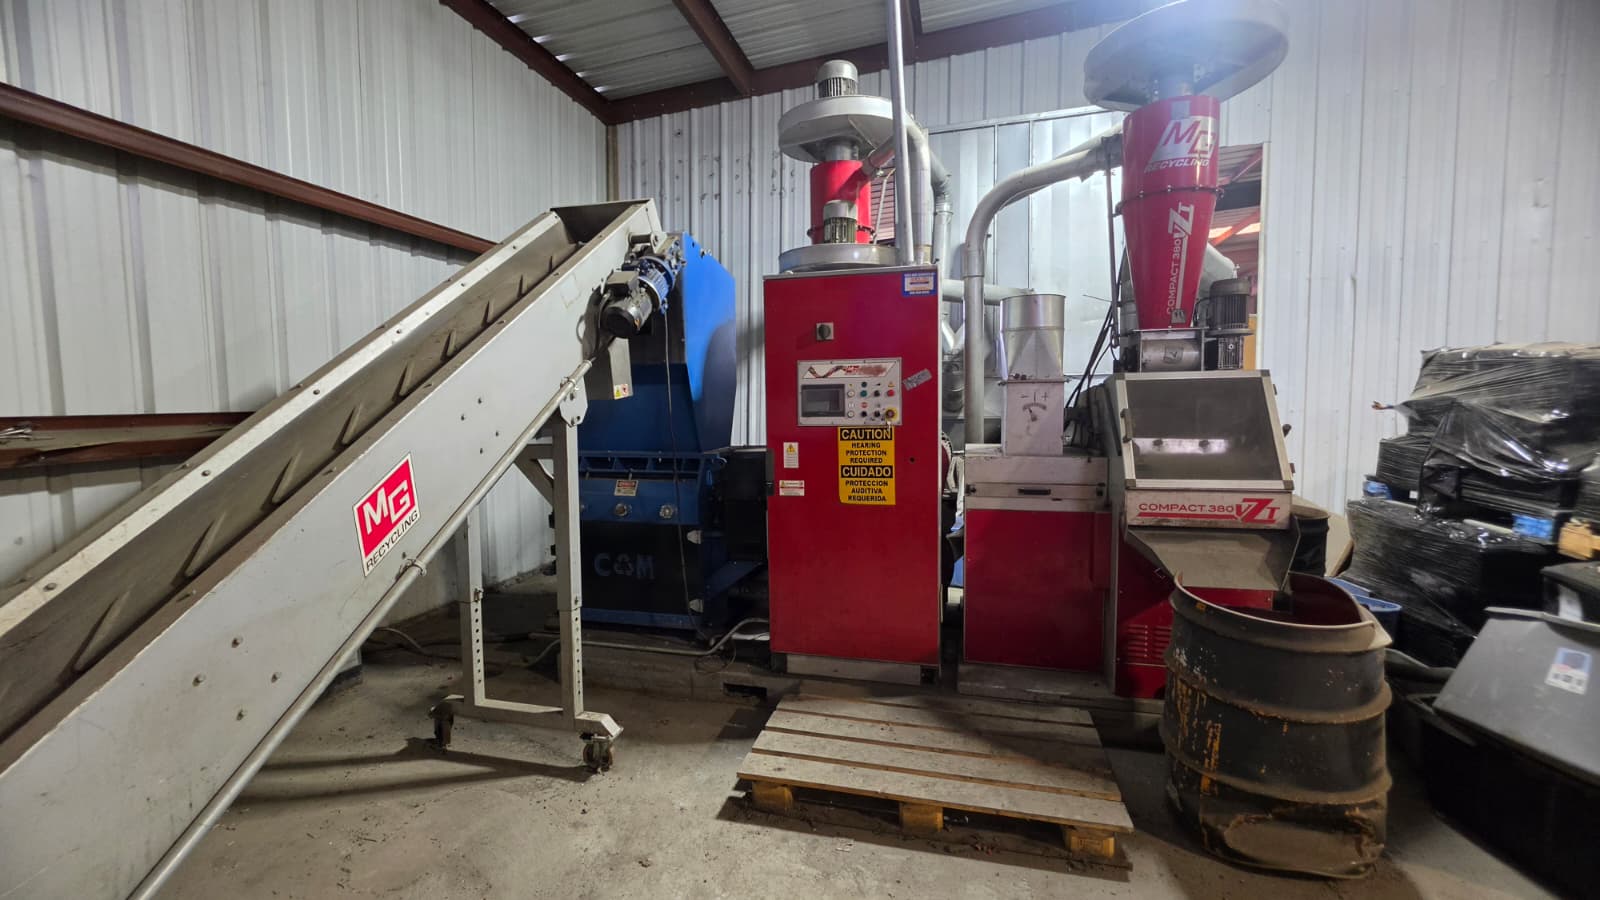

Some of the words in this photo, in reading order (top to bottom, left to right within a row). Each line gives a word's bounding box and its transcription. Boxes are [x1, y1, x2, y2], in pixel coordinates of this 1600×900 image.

[1166, 262, 1179, 315] COMPACT
[841, 429, 891, 440] CAUTION
[845, 449, 887, 457] PROTECTION
[842, 466, 892, 477] CUIDADO
[362, 480, 411, 536] MG
[1138, 503, 1204, 512] COMPACT
[1208, 504, 1234, 513] 380
[366, 510, 419, 572] RECYCLING
